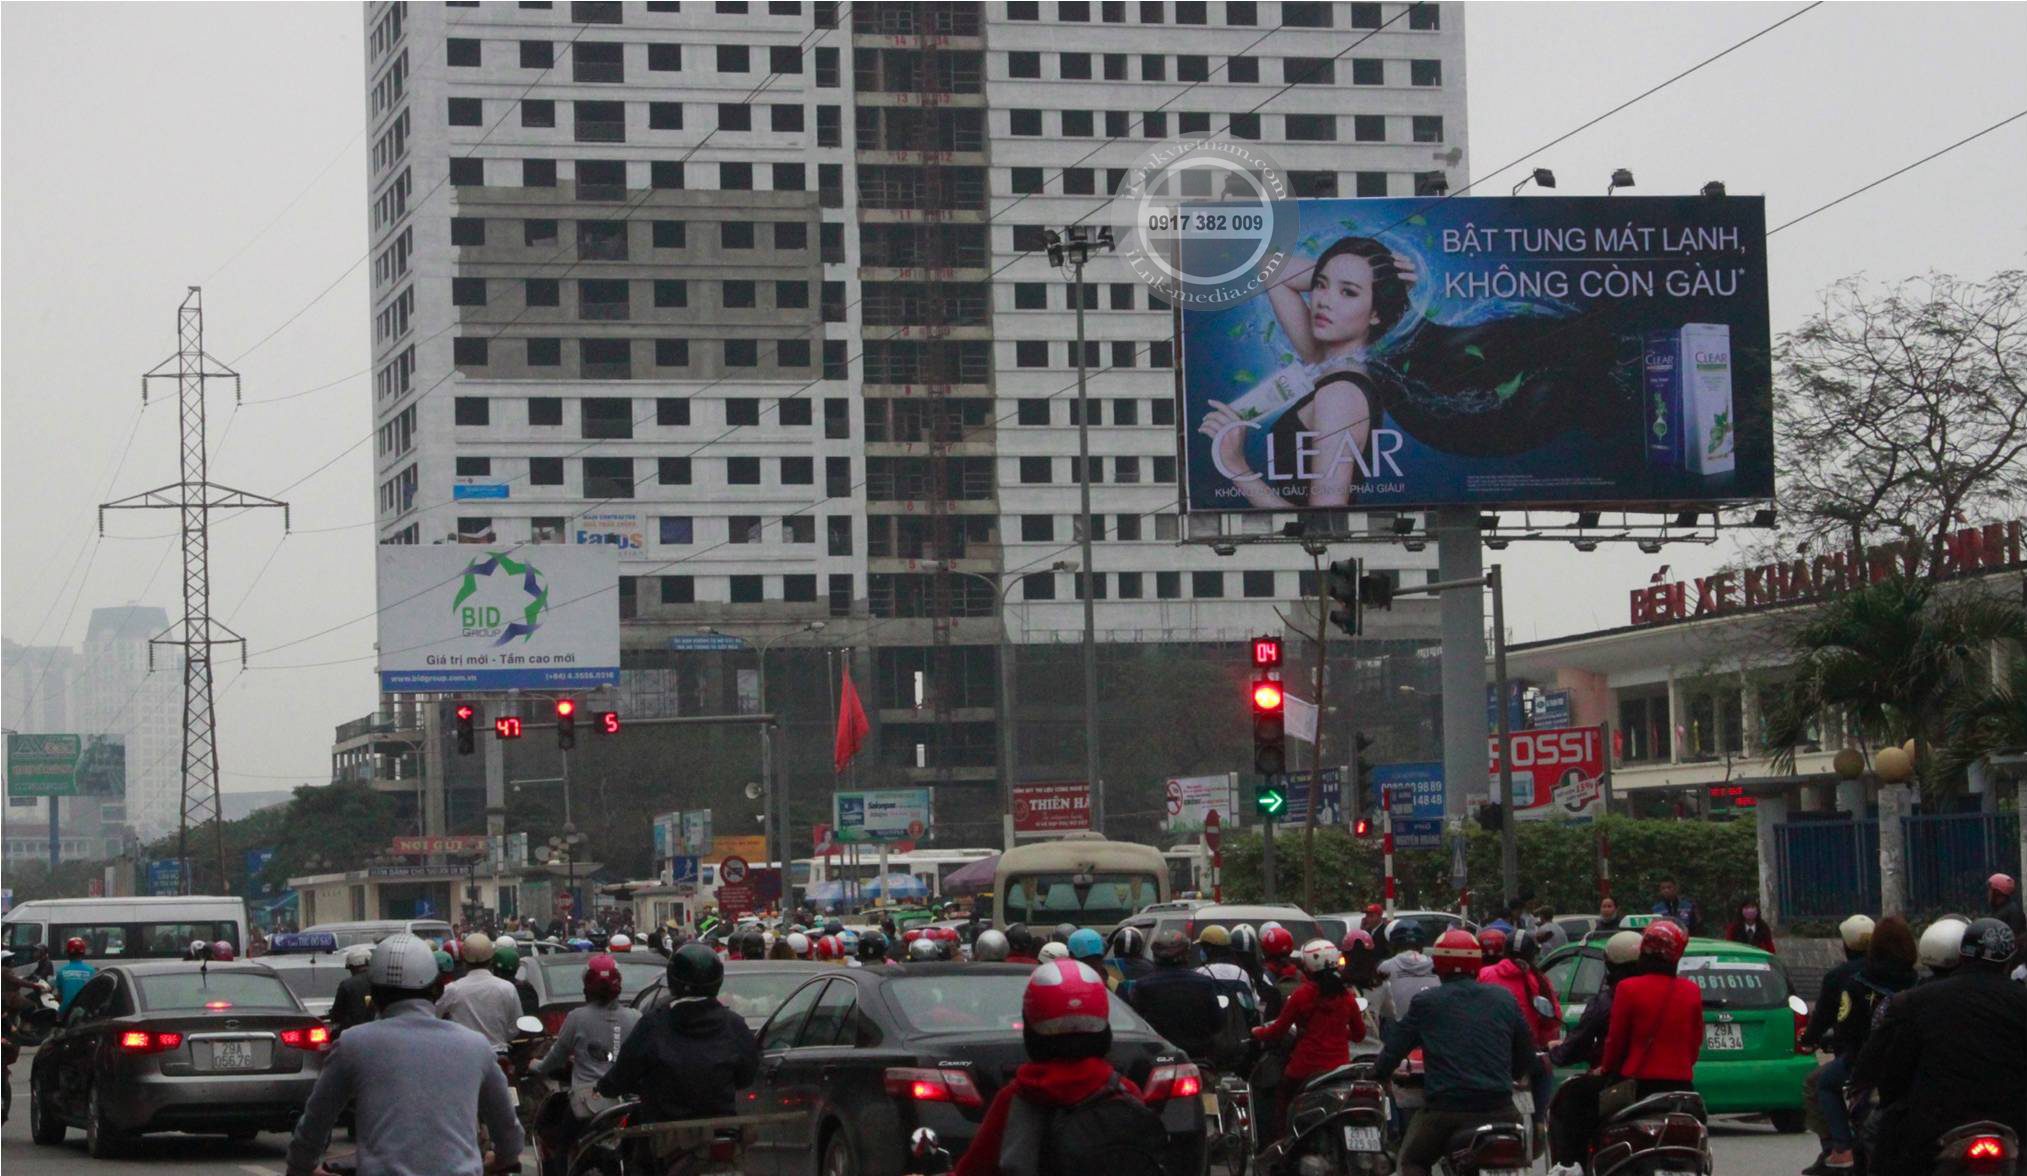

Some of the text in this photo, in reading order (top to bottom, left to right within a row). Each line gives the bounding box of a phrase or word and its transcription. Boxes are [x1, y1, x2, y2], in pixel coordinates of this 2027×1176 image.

[1442, 222, 1745, 257] BẬT TUNG MÁT LẠNH,
[1444, 264, 1569, 298] KHÔNG
[1580, 264, 1653, 297] CÒN
[1695, 351, 1728, 364] CLEAR
[1211, 420, 1404, 480] CLEAR
[1630, 565, 1686, 625] BẾN
[1694, 572, 1738, 616] XE
[462, 607, 500, 628] BID
[426, 655, 447, 665] Giá
[450, 655, 464, 668] trị
[466, 655, 489, 665] mới
[529, 655, 551, 664] cao
[554, 653, 576, 664] mới
[1257, 643, 1276, 662] 04
[496, 718, 519, 736] 47
[605, 713, 618, 732] 5
[1029, 796, 1070, 811] THIÊN
[1714, 1023, 1732, 1036] 29A
